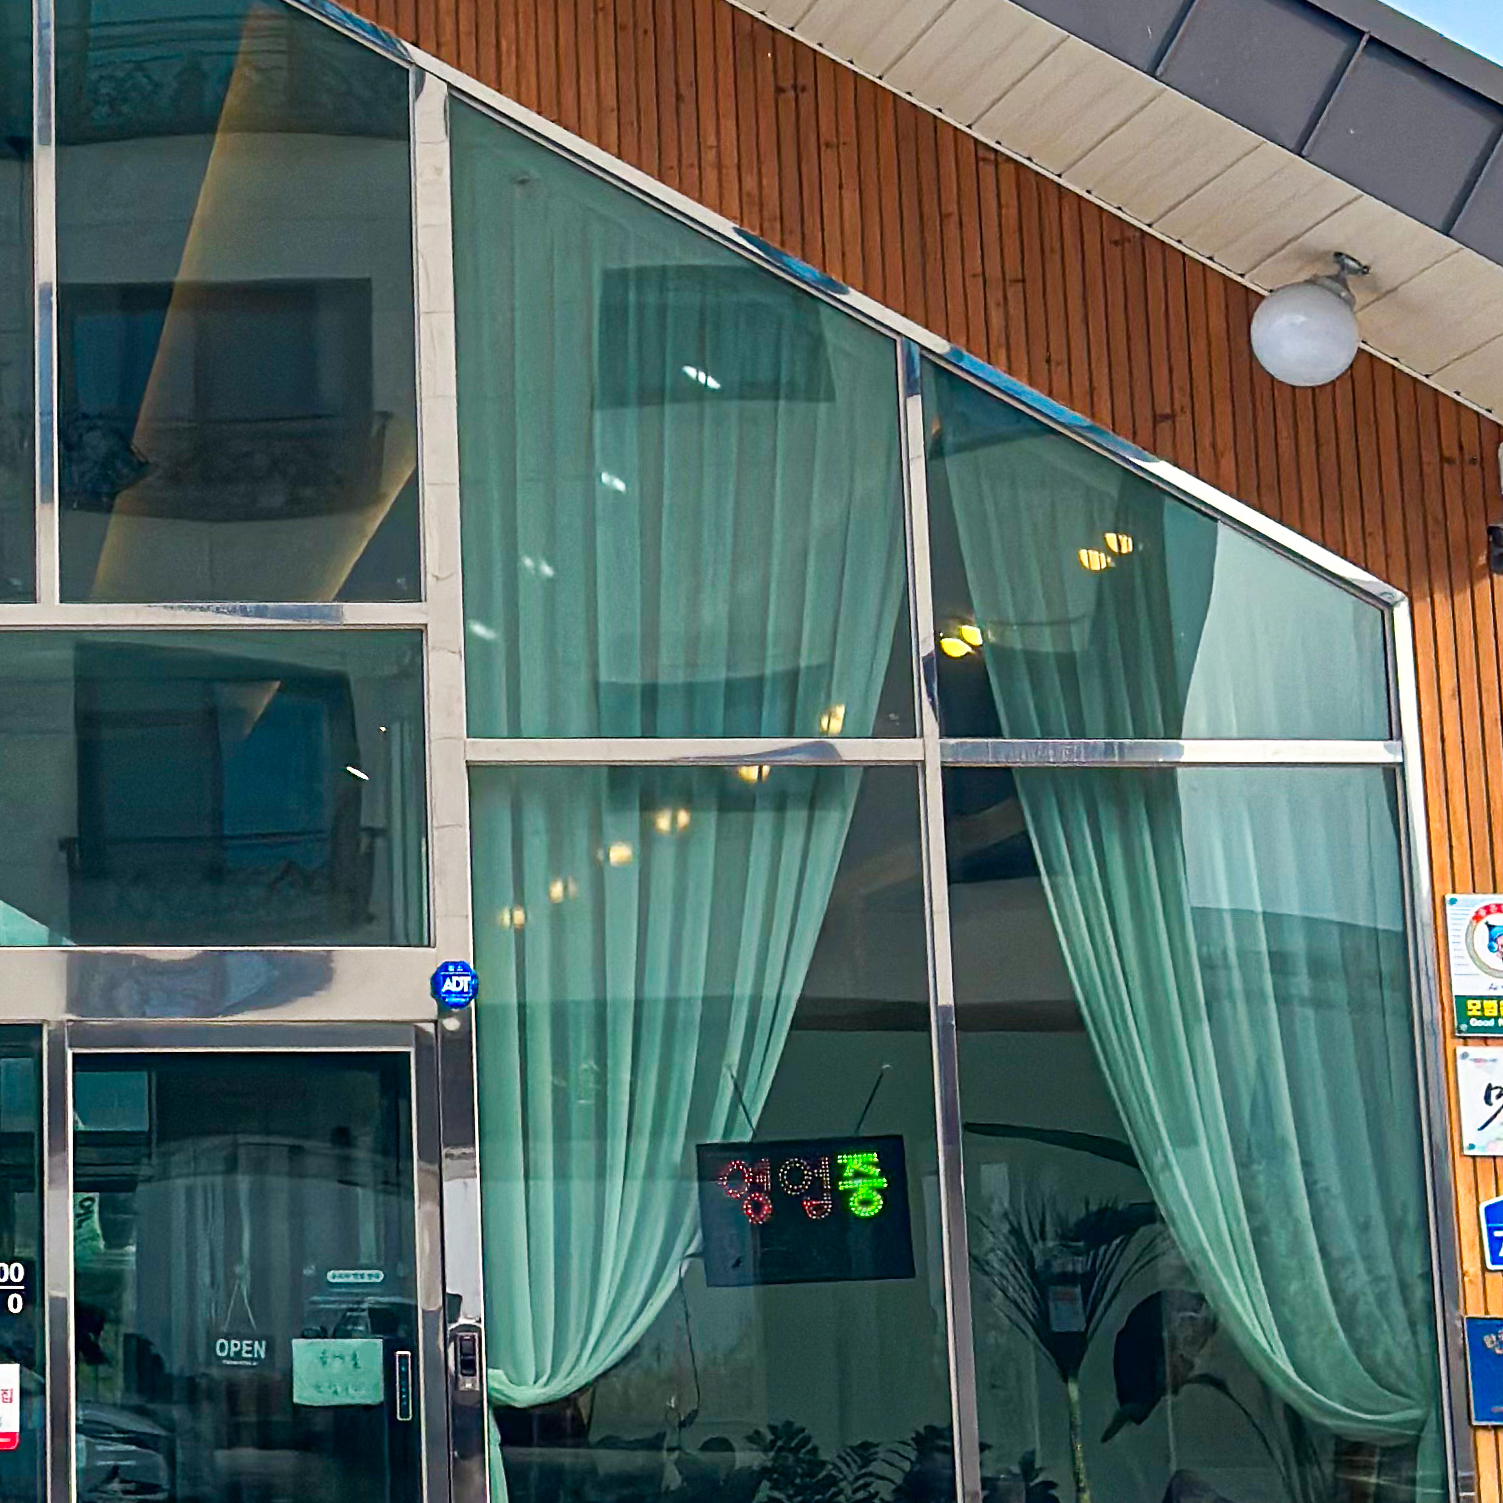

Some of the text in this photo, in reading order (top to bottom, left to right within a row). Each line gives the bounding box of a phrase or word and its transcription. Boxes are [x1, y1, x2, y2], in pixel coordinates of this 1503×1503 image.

[441, 975, 472, 993] ADT
[1469, 1017, 1496, 1027] Good
[215, 1338, 266, 1359] OPEN
